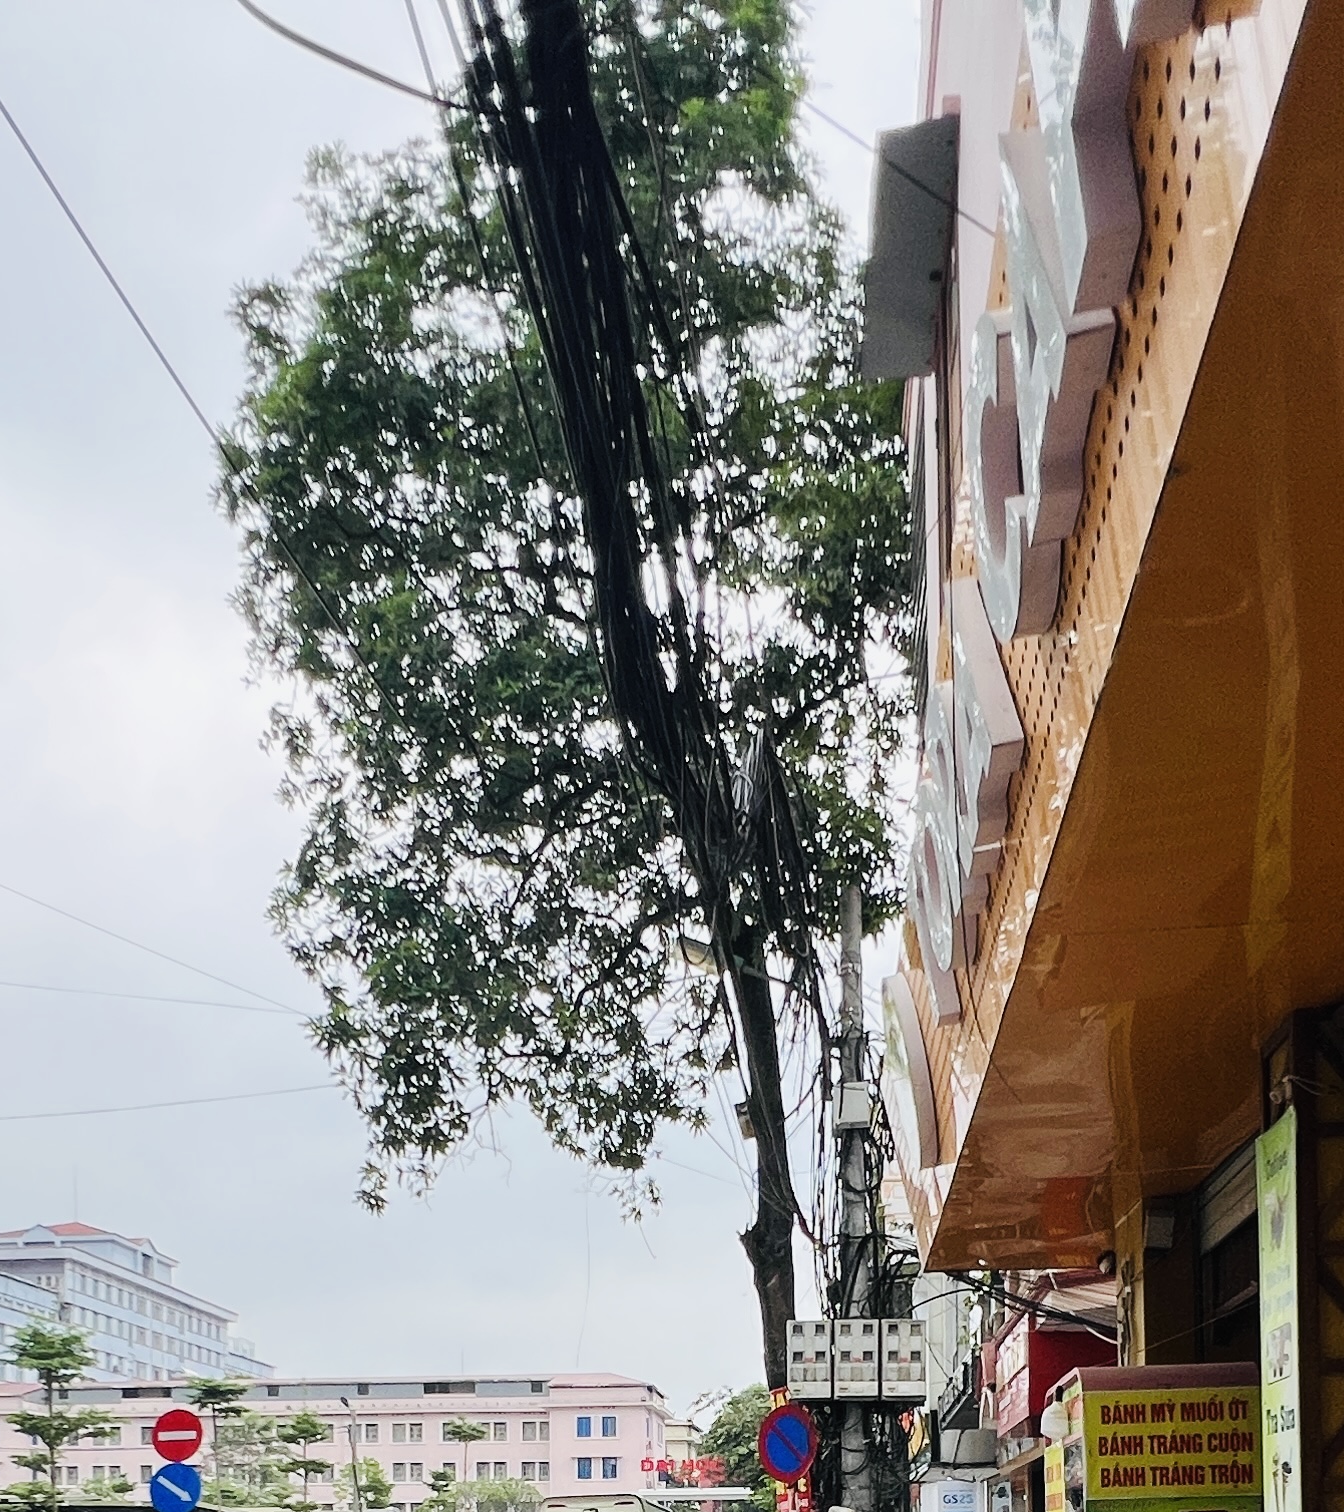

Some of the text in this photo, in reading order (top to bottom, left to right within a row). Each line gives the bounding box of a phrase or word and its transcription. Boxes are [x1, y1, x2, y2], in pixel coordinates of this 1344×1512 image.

[1100, 1400, 1146, 1425] BÁNH
[1180, 1394, 1224, 1423] MUỐI
[1098, 1427, 1253, 1457] BÁNH TRÁNG CUỘN
[1100, 1459, 1253, 1488] BÁNH TRÁNG TRỘN
